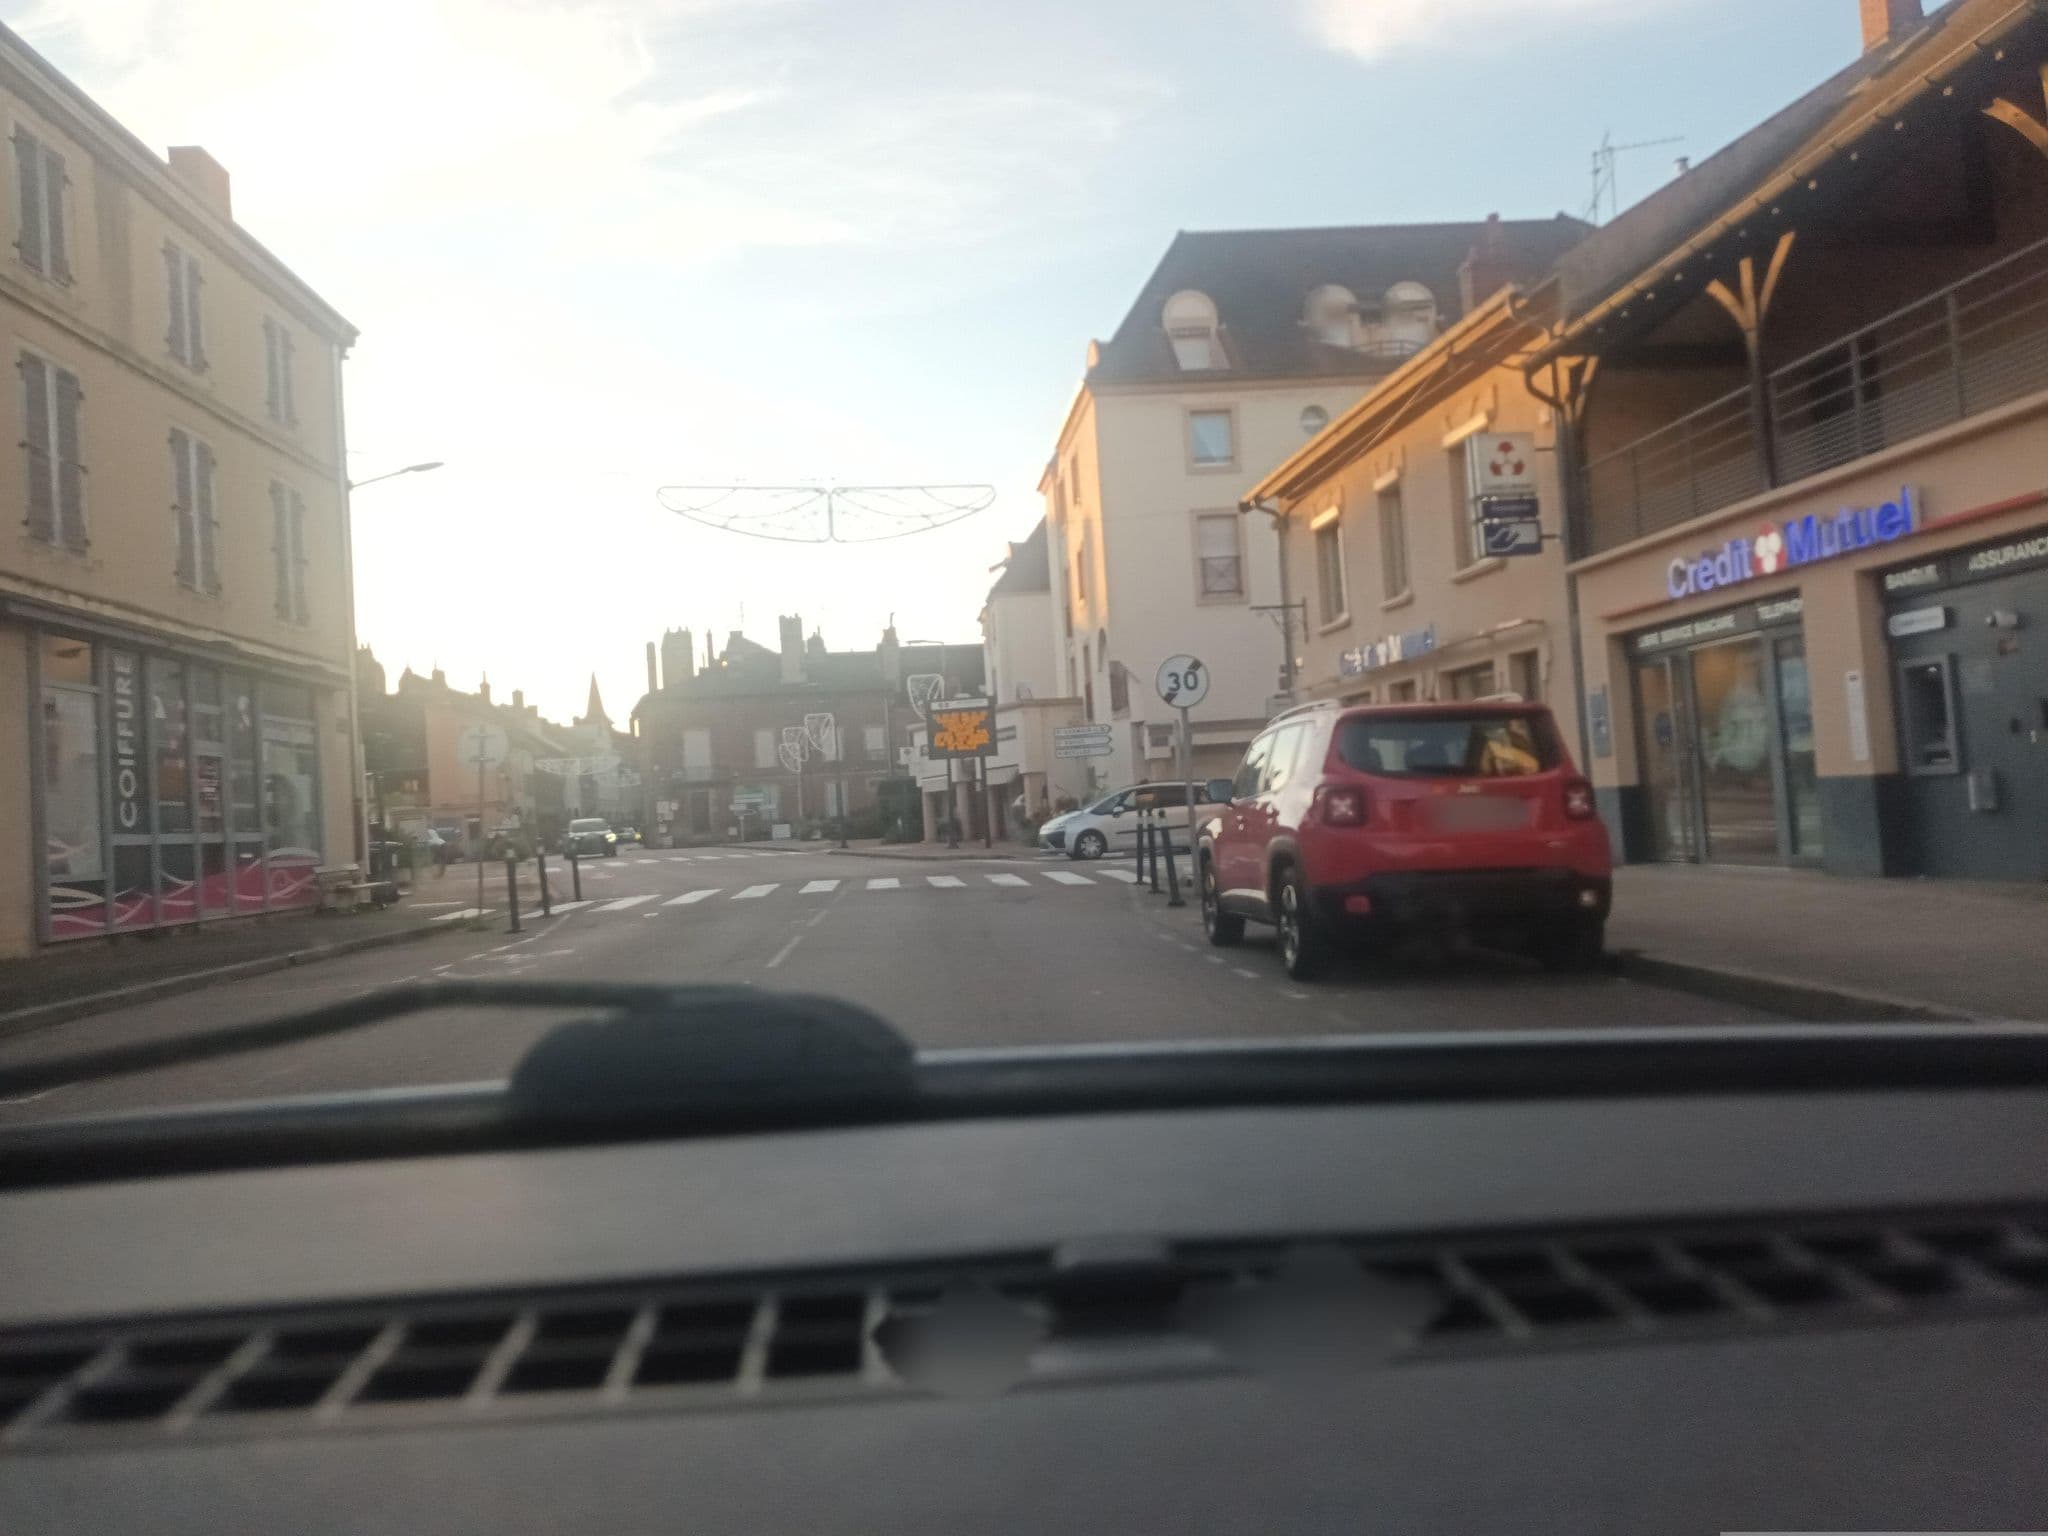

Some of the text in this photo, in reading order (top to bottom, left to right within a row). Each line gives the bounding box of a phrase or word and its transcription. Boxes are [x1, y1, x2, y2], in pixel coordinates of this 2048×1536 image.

[1784, 484, 1913, 566] Mutuel
[1166, 670, 1199, 693] 30
[115, 654, 138, 828] COIFFURE
